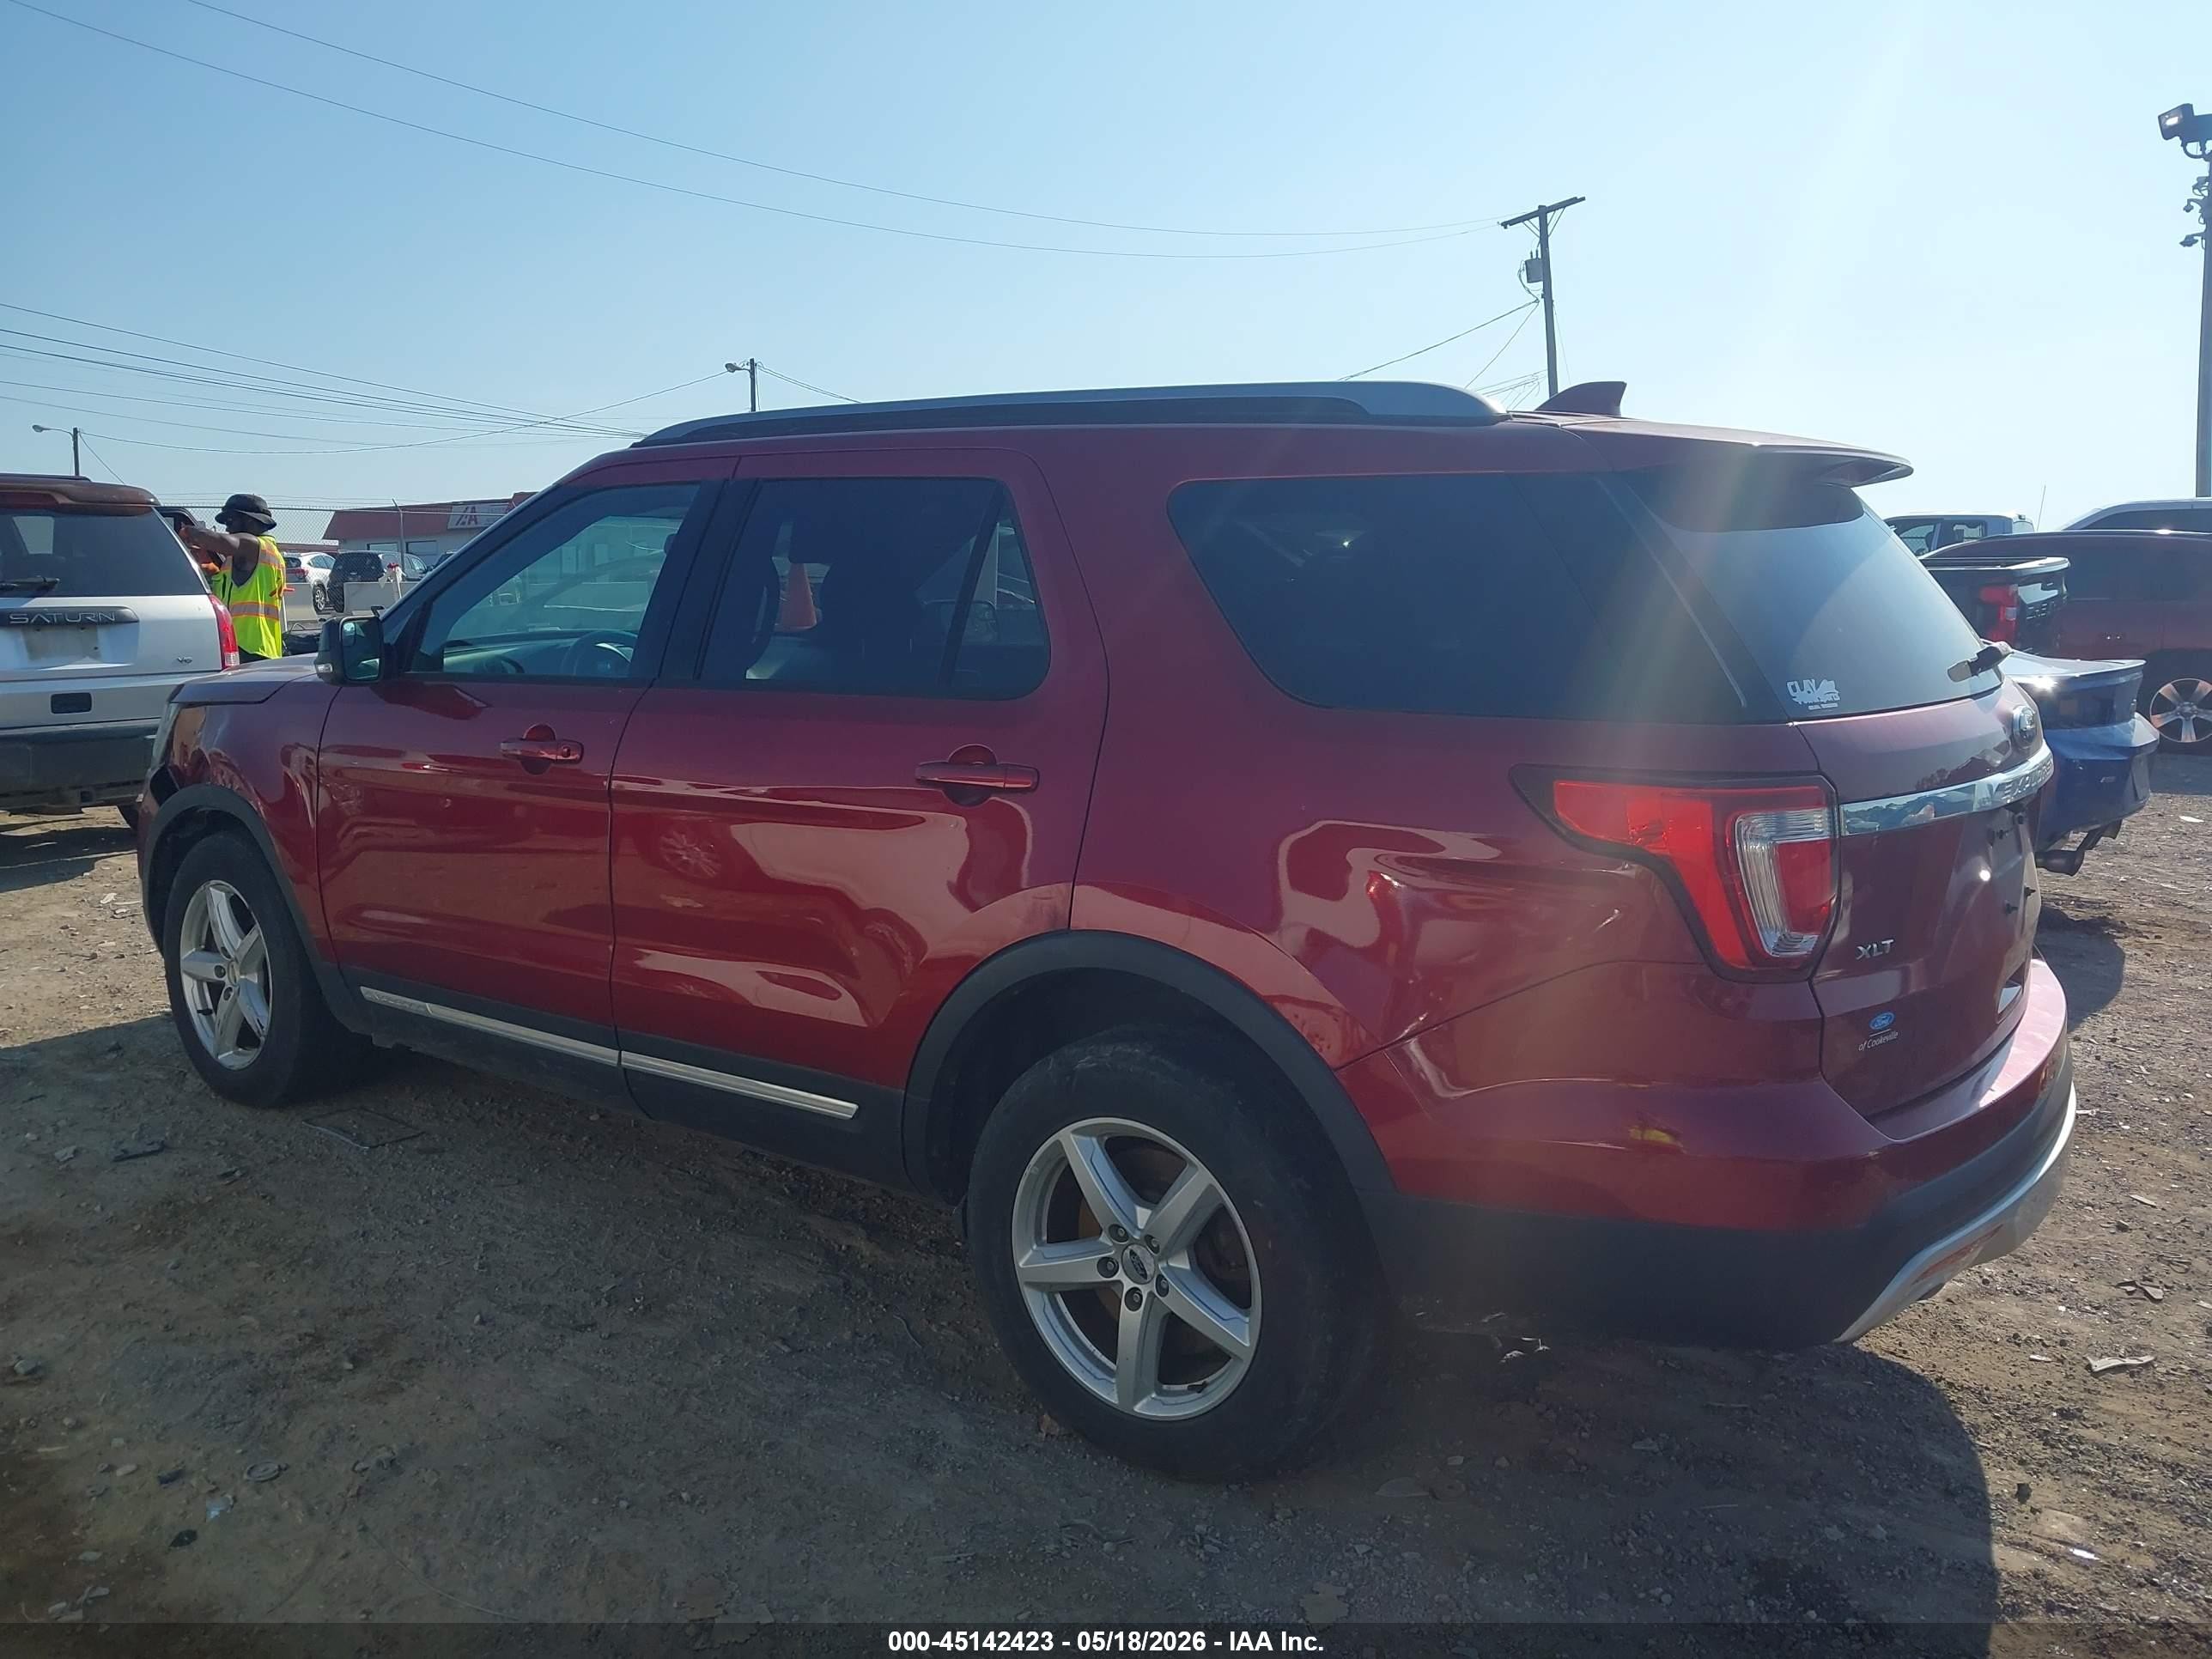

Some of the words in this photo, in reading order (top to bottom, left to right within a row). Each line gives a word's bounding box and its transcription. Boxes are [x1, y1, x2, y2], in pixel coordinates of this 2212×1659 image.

[9, 611, 116, 624] SATURN
[2001, 760, 2053, 799] EXPLORE
[1856, 939, 1894, 960] XLT
[1858, 1040, 1868, 1051] of
[1867, 1030, 1899, 1048] Cookeville
